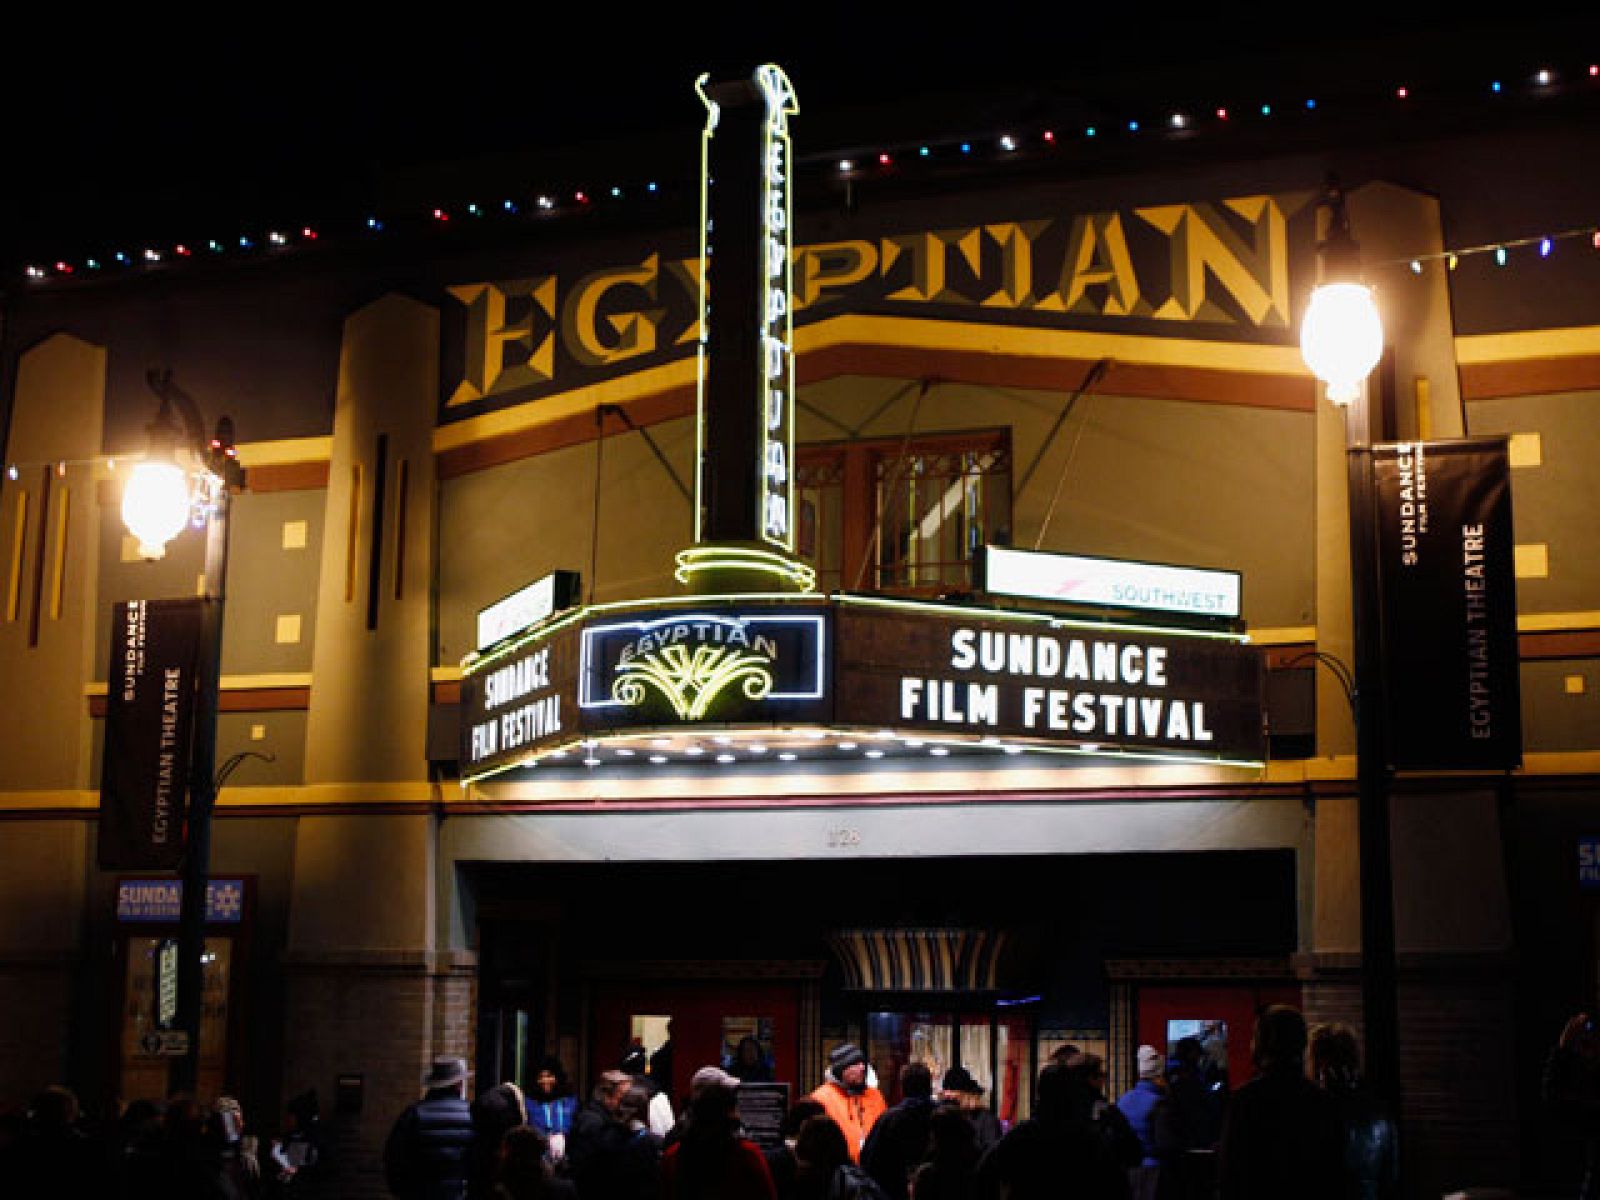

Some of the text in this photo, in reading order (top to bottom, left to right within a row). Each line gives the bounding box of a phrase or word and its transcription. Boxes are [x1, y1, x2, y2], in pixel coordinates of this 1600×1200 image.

[1398, 442, 1417, 566] SUNDANCE
[1110, 583, 1229, 611] SOUTHWEST
[124, 600, 138, 701] SUNDANCE
[620, 622, 778, 664] EGYPTIAN
[951, 628, 1168, 687] SUNDANCE
[1462, 523, 1491, 739] EGYPTIAN THEATRE
[484, 649, 550, 711] SUNDANCE
[900, 677, 1213, 742] FILM FESTIVAL
[152, 667, 181, 843] EGYPTIAN THEATRE
[471, 694, 562, 762] FILM FESTIVAL
